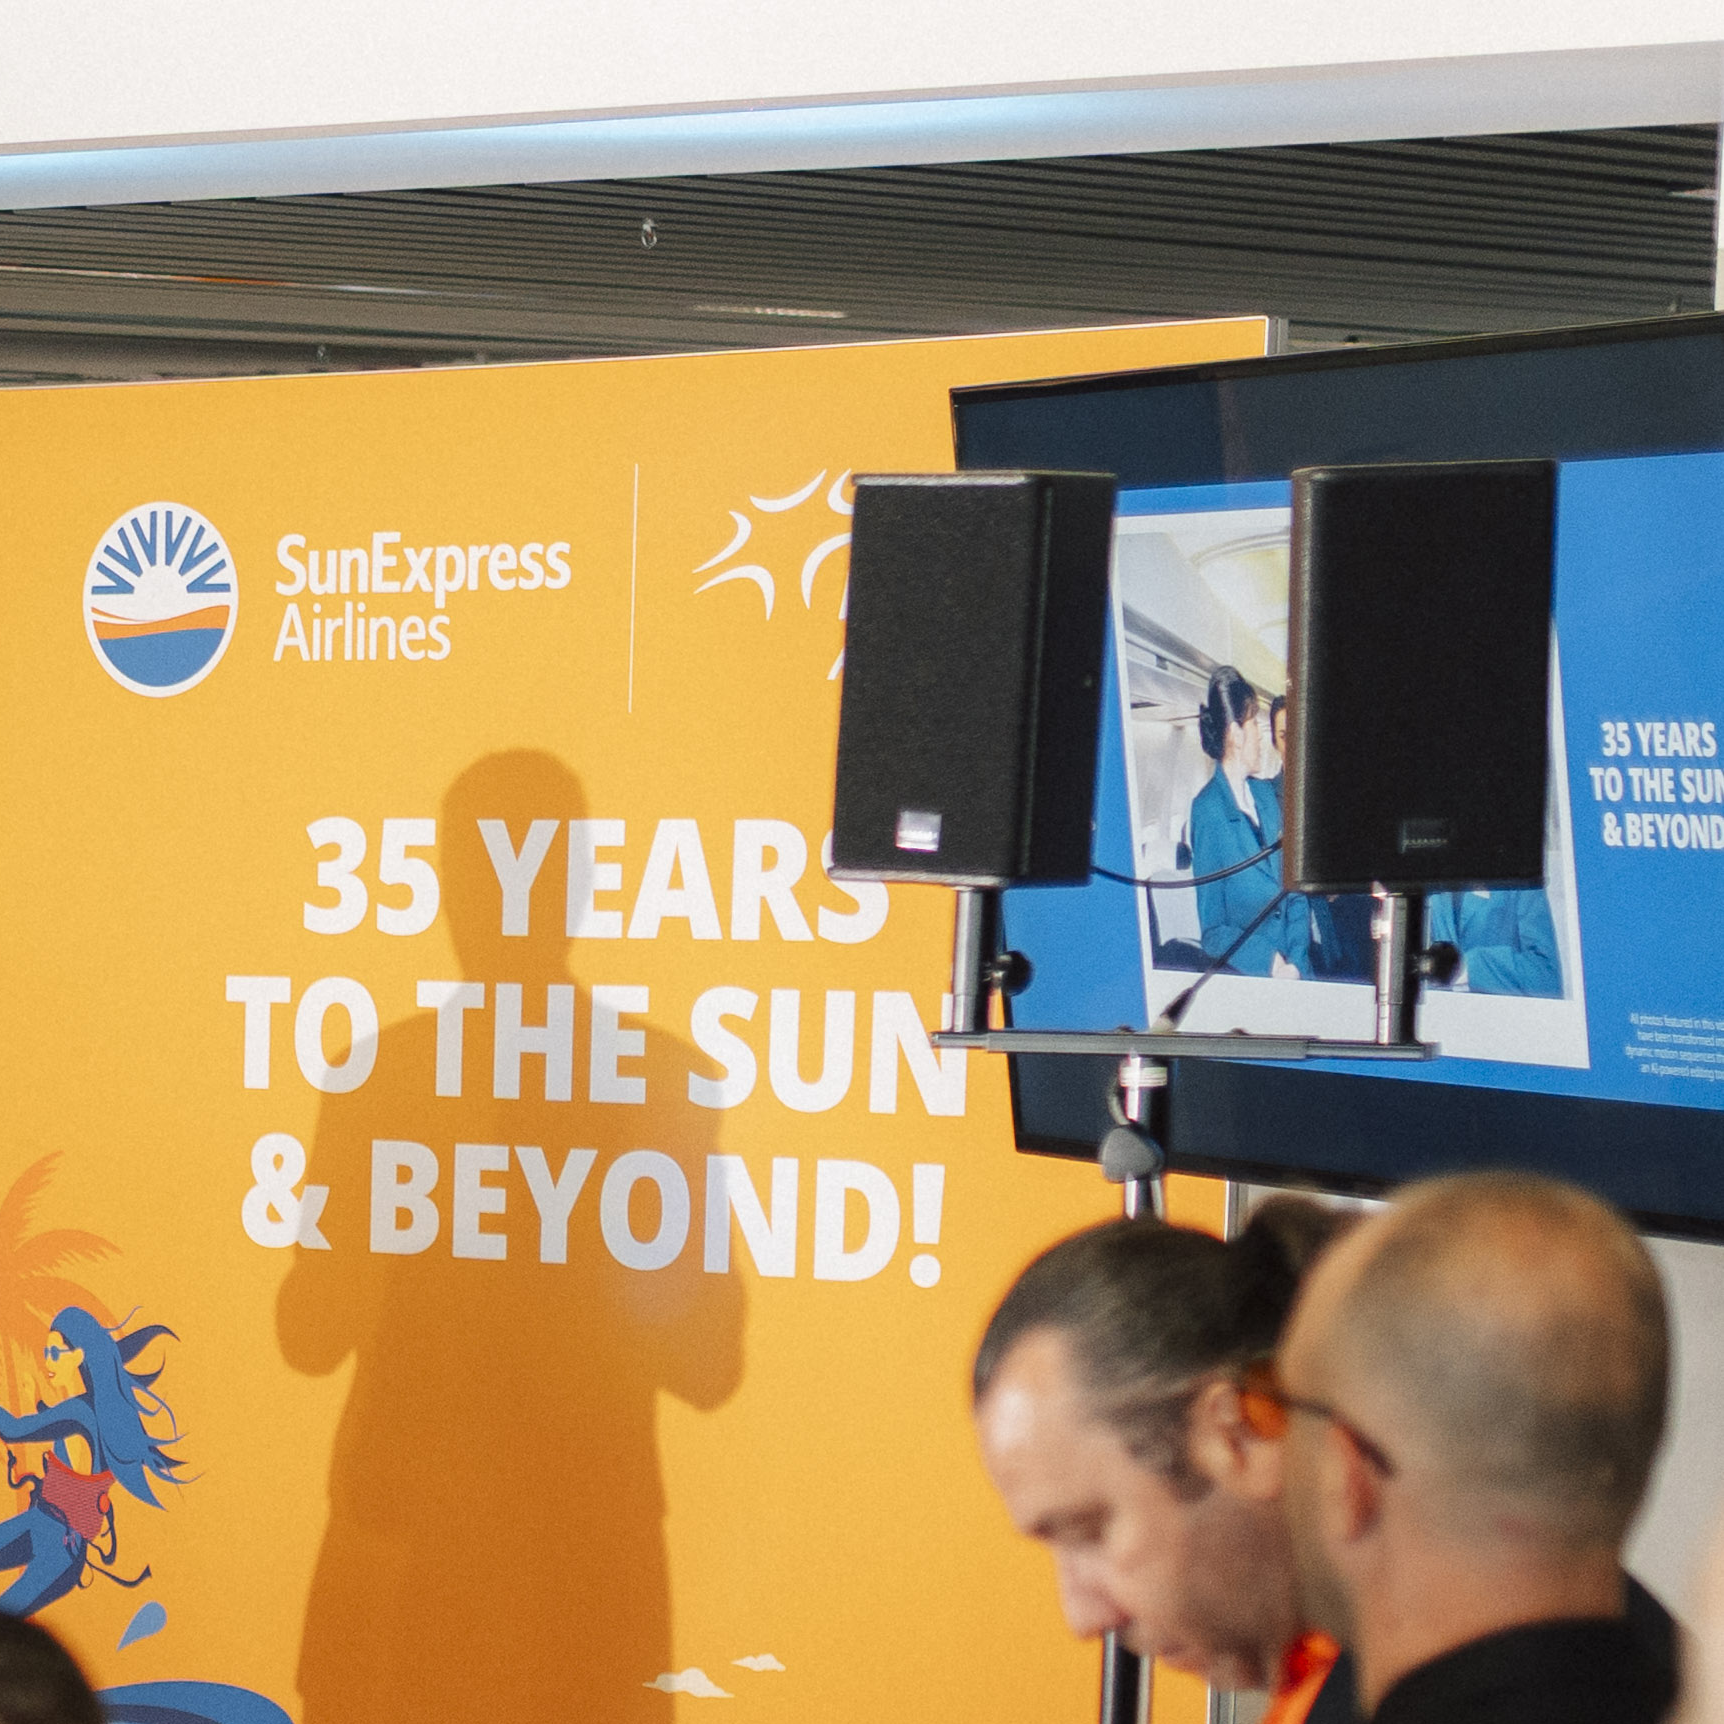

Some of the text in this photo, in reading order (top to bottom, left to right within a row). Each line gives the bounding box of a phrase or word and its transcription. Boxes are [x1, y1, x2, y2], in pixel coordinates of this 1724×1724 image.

[275, 530, 571, 607] SunExpress
[272, 604, 452, 662] Airlines
[1601, 722, 1717, 758] 35 YEARS
[1589, 767, 1624, 802] TO
[1628, 768, 1676, 803] THE
[1603, 812, 1624, 847] &
[303, 815, 890, 944] 35 YEARS
[225, 976, 968, 1117] TO THE SUN
[240, 1132, 946, 1289] & BEYOND!
